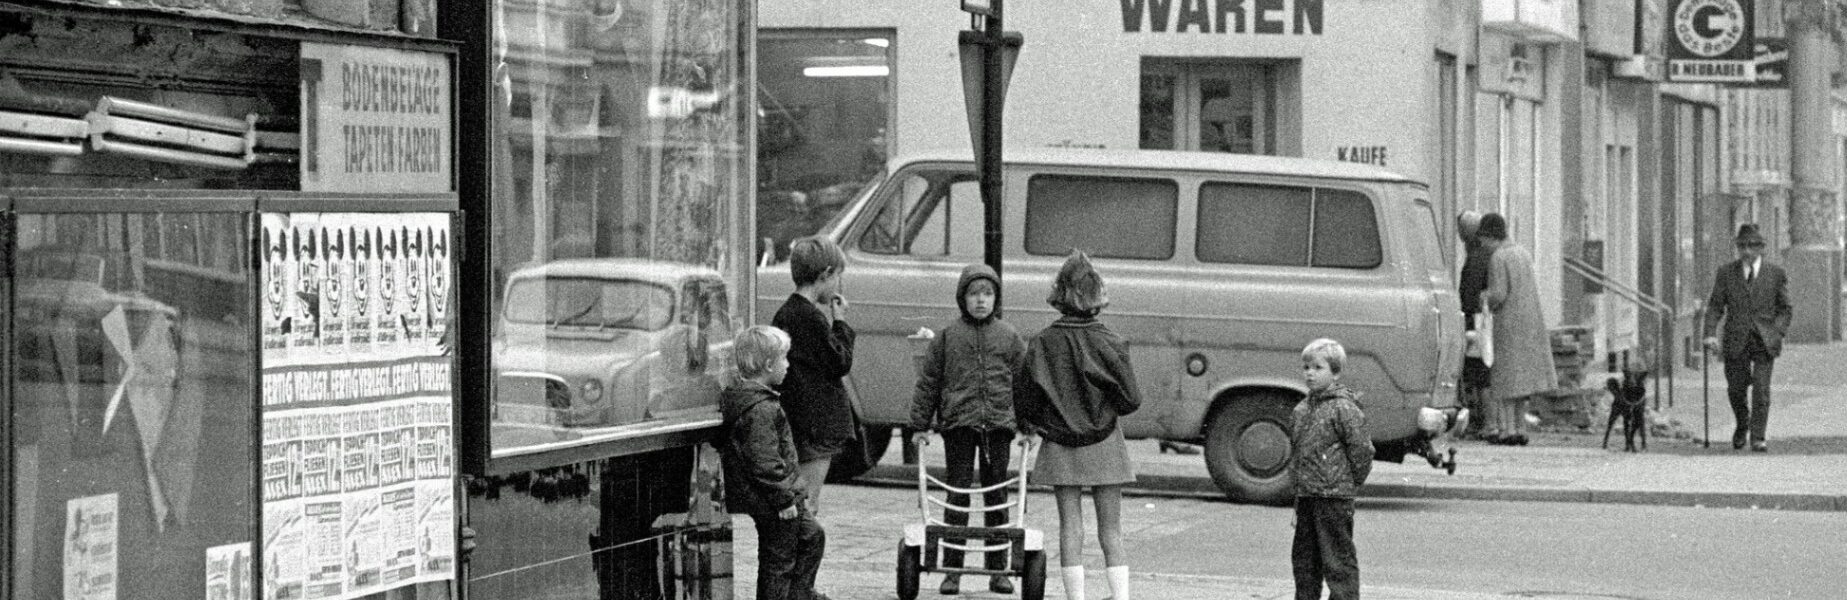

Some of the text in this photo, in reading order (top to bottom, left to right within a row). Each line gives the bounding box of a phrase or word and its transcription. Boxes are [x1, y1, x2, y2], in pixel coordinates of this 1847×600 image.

[1120, 0, 1324, 35] WAREN
[1683, 63, 1744, 76] NEUBAUER
[343, 62, 439, 115] BODENBELÄGE
[343, 125, 440, 173] TAPETEN FARBEN
[1338, 146, 1386, 167] KAUFE
[263, 373, 292, 405] FERTIG
[331, 369, 358, 399] FERTIG
[393, 362, 419, 394] FERTIG
[381, 464, 401, 484] ALEX
[417, 460, 437, 478] ALEX
[265, 480, 287, 501] ALEX
[305, 475, 328, 495] ALEX
[344, 470, 366, 490] ALEX
